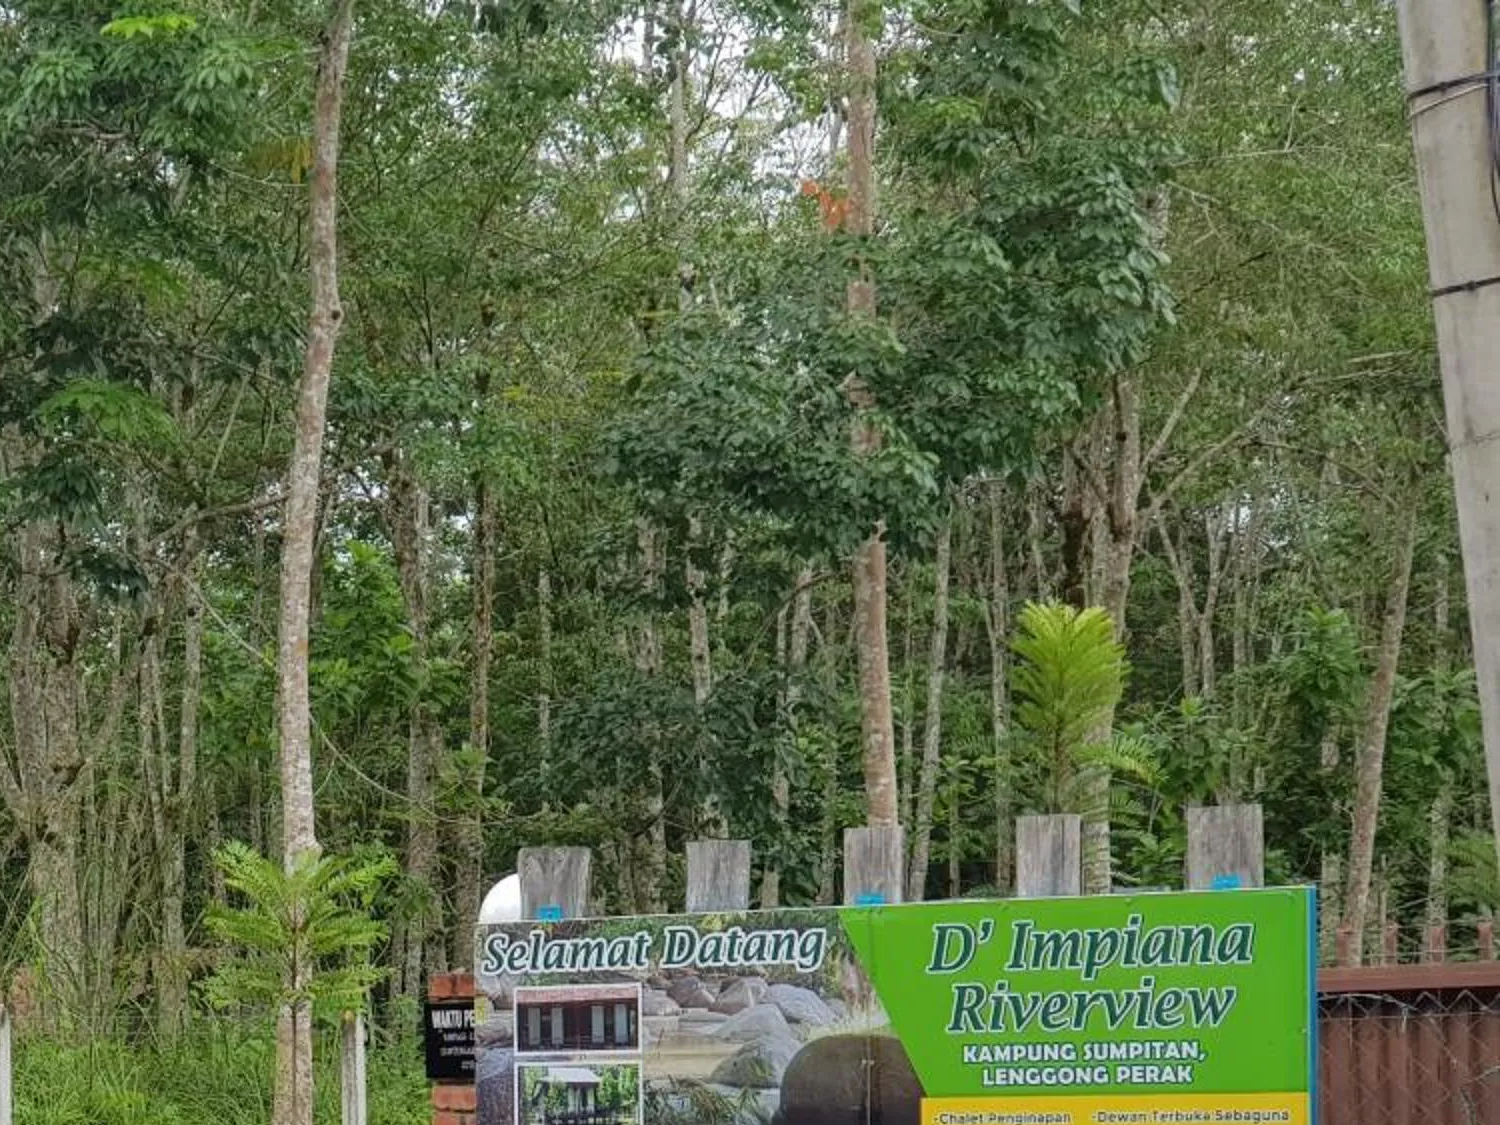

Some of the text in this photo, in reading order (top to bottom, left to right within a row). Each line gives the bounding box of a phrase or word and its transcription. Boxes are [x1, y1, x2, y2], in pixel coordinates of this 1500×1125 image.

[483, 925, 827, 976] Selamat Datang
[925, 914, 1256, 981] D' Impiana
[946, 976, 1237, 1033] Riverview
[963, 1041, 1206, 1064] KAMPUNG SUMPITAN,
[983, 1065, 1193, 1086] LENGGONG PERAK
[988, 1112, 1071, 1125] Penginapan
[1152, 1110, 1211, 1122] Terbuka
[1215, 1109, 1289, 1124] Sebaguna
